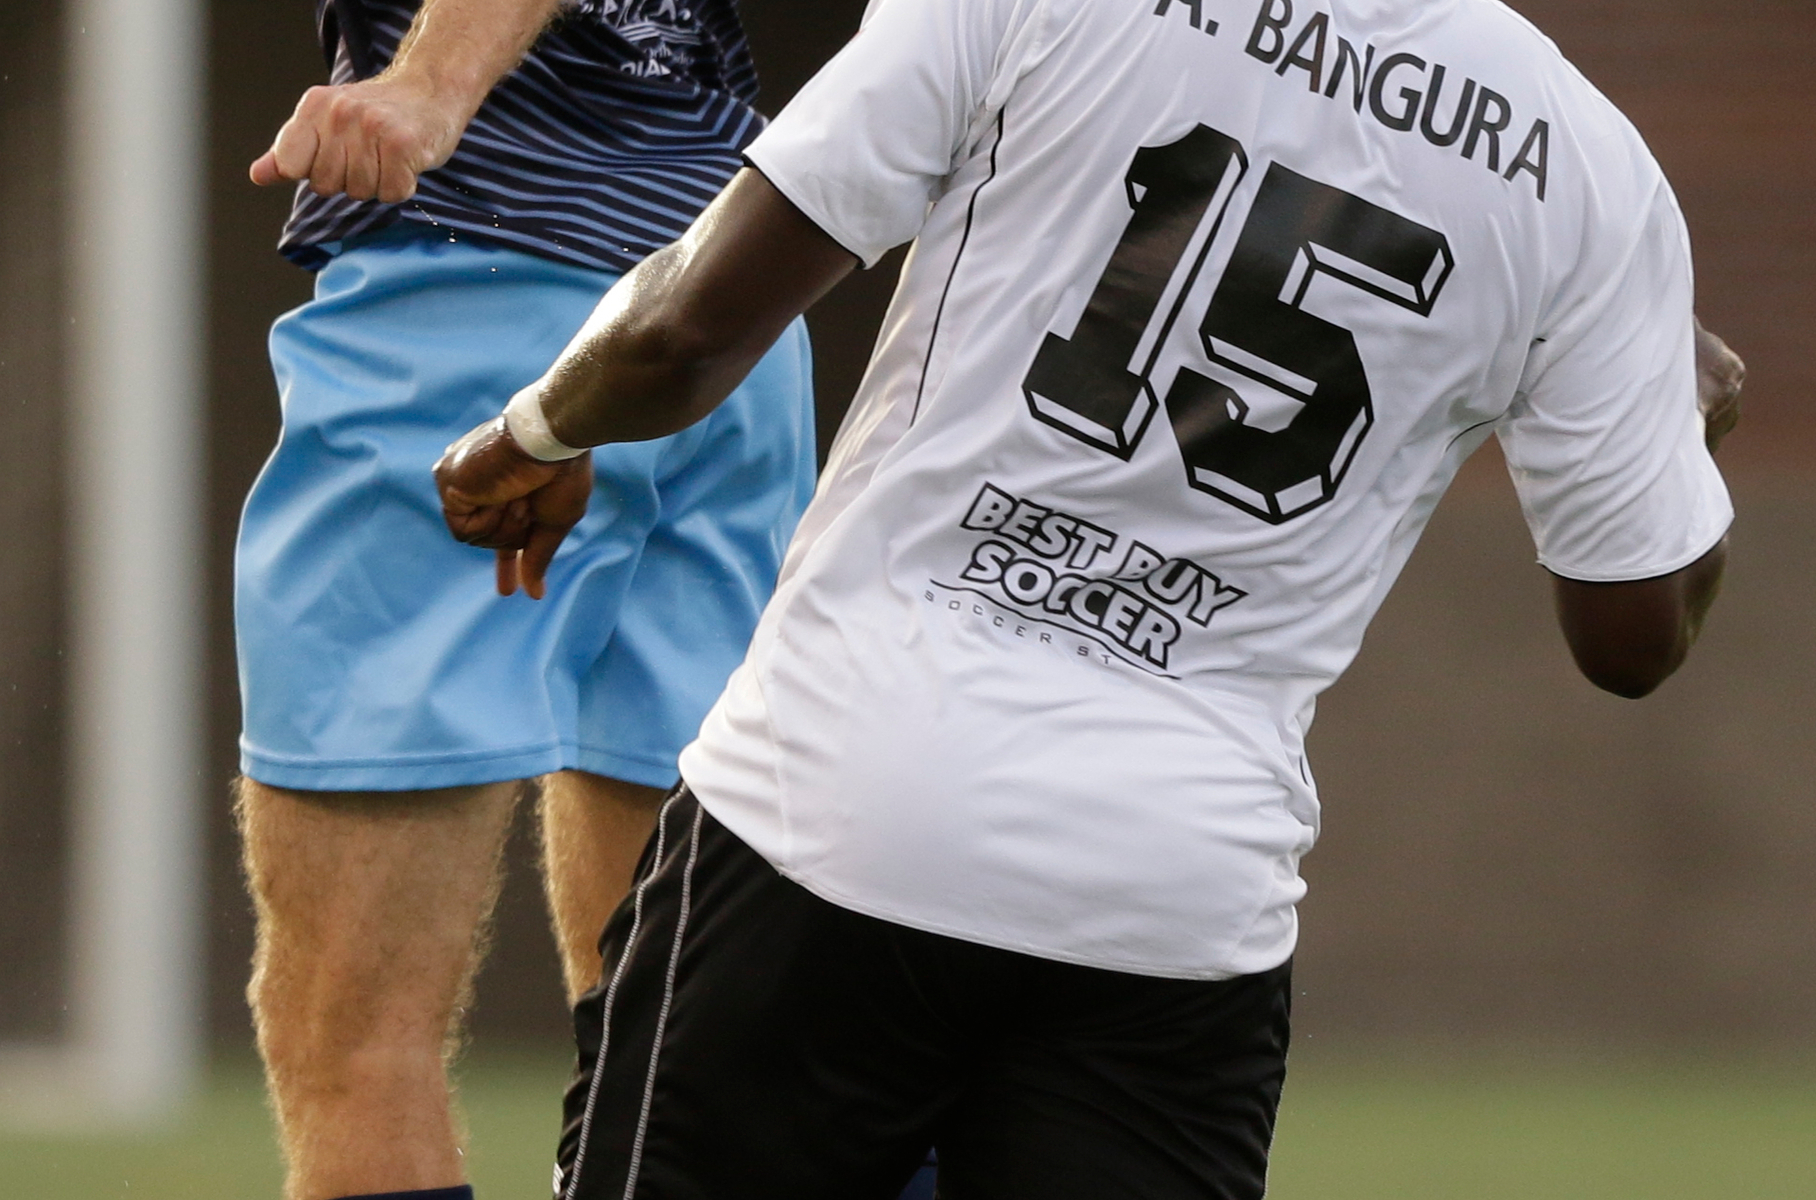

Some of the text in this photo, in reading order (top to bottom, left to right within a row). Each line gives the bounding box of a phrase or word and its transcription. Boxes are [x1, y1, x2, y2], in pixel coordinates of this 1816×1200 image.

[1022, 122, 1454, 525] 15
[924, 590, 1052, 644] SOCCER
[960, 481, 1249, 628] BEST BUY
[960, 540, 1181, 669] SOCCER
